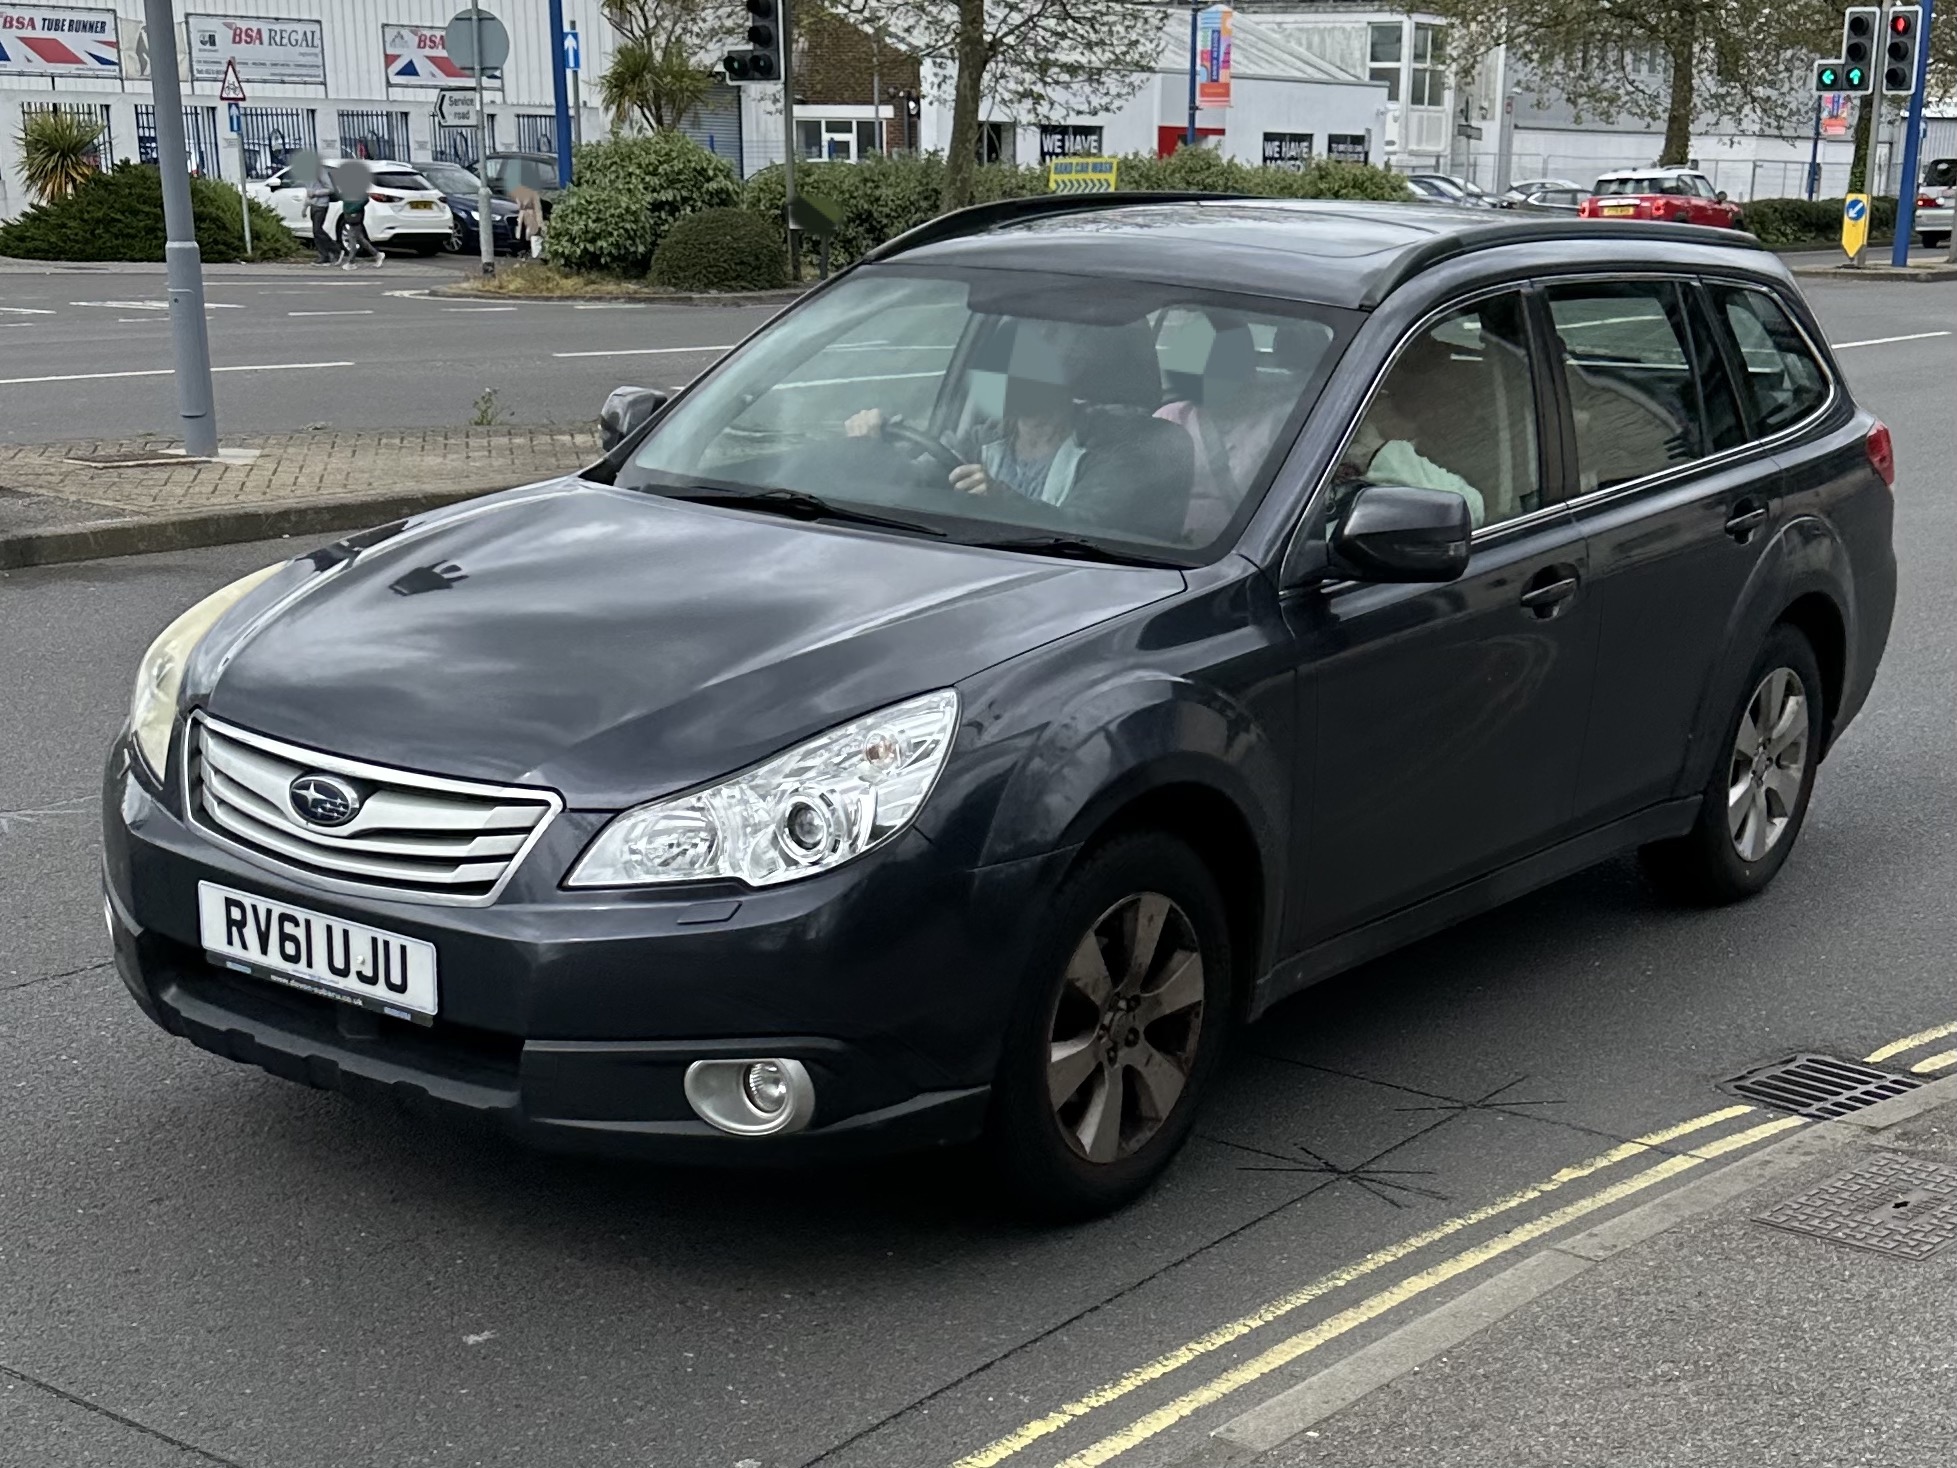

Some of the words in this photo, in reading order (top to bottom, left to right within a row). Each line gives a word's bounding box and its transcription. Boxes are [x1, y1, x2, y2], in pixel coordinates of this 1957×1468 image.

[2, 15, 36, 30] BSA
[41, 18, 66, 32] TUBE
[67, 19, 107, 34] RUNNER
[231, 26, 264, 46] BSA
[267, 28, 319, 48] REGAL
[448, 96, 474, 107] Service
[453, 110, 471, 120] road
[1042, 134, 1062, 153] WE
[1064, 135, 1098, 154] HAVE
[1264, 141, 1280, 158] WE
[1281, 141, 1309, 158] HAVE
[224, 896, 313, 969] RV61
[326, 924, 408, 994] UJU
